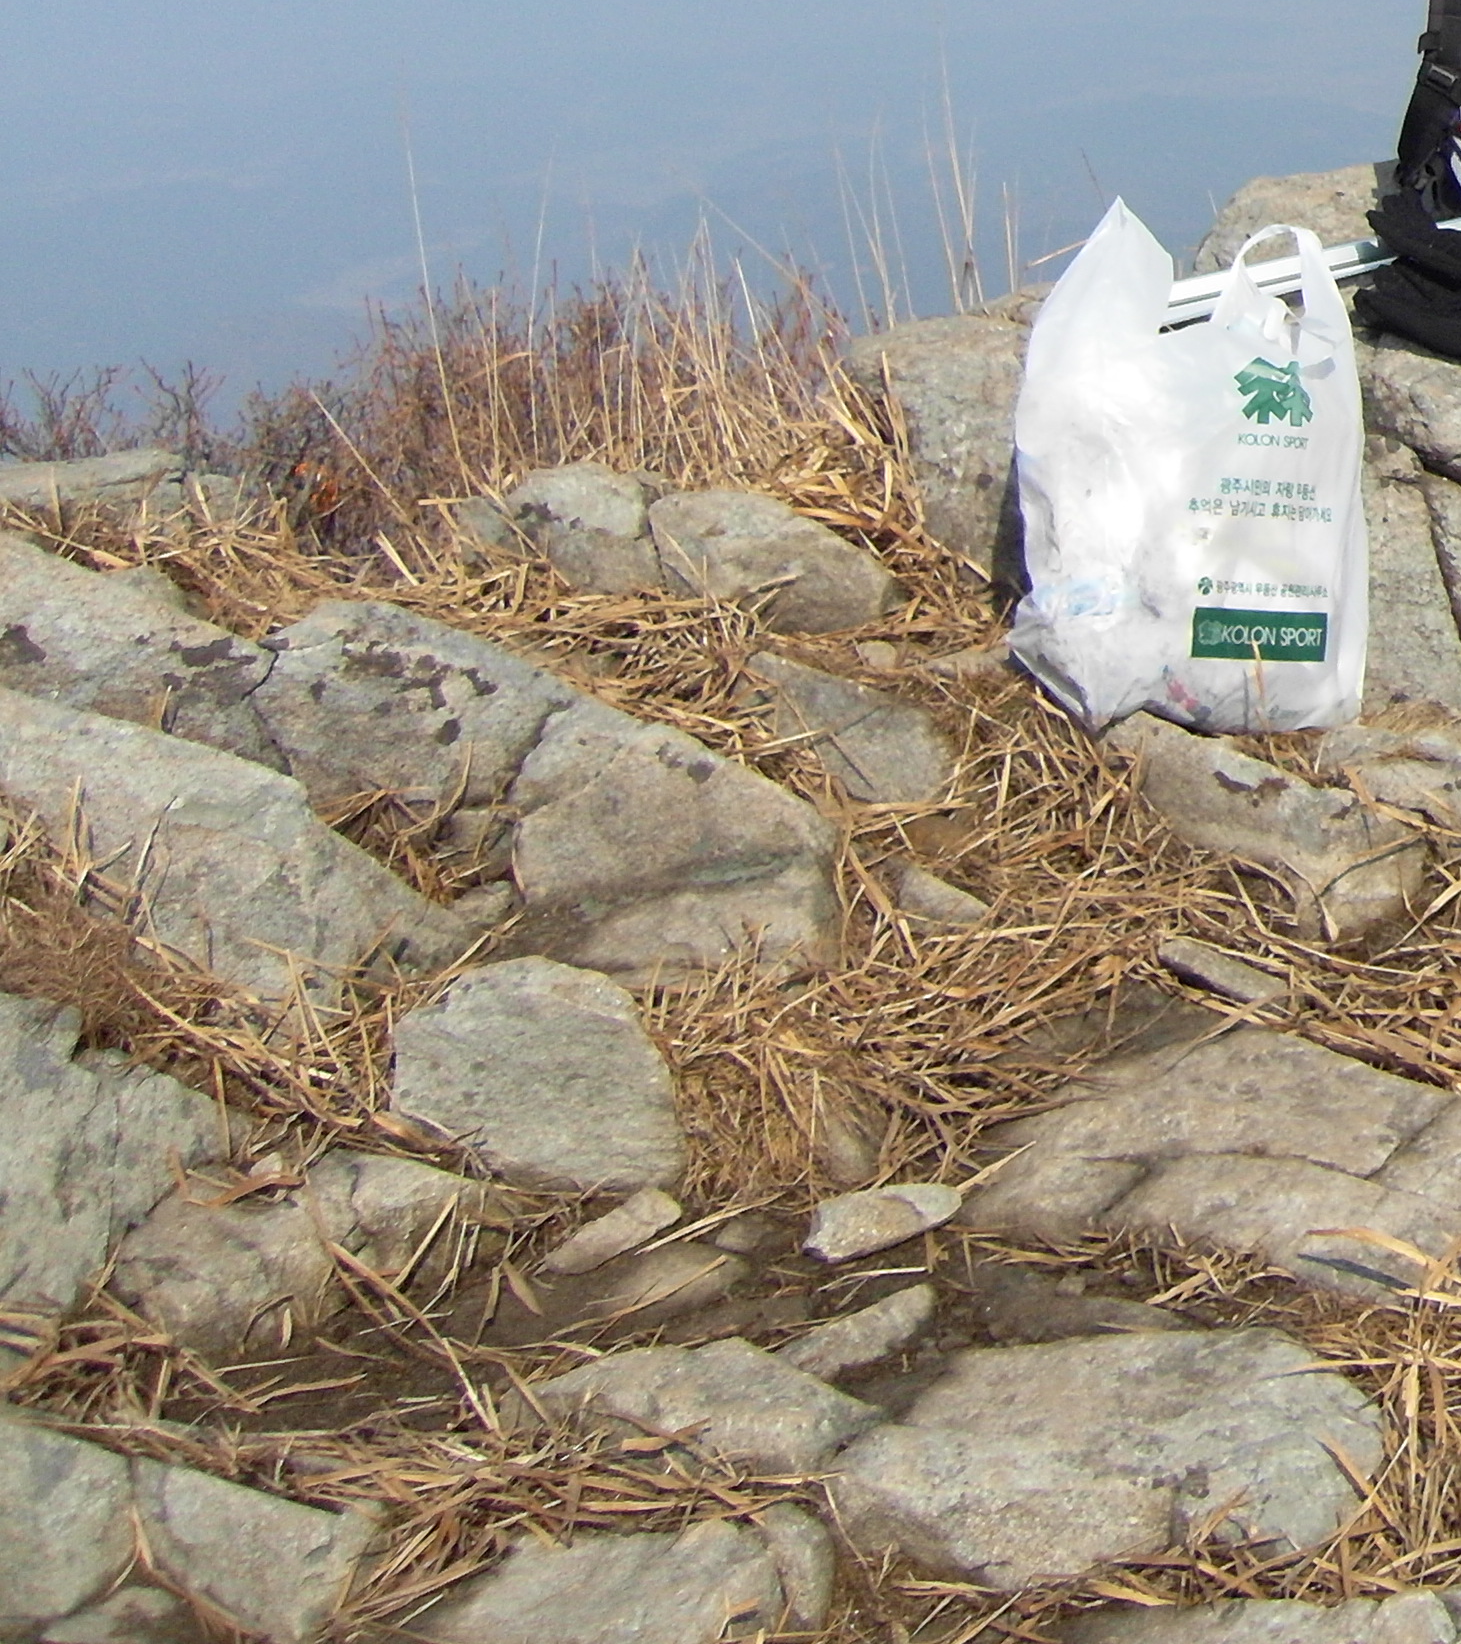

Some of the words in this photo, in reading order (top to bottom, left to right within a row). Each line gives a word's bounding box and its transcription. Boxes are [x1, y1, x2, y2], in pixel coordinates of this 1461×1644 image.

[1237, 433, 1280, 446] KOLON
[1283, 435, 1309, 449] SPORT
[1220, 477, 1271, 496] 광주시민의
[1275, 481, 1295, 499] 자랑
[1188, 497, 1223, 516] 추억은
[1230, 499, 1266, 517] 남기시고
[1271, 502, 1297, 521] 휴지는
[1221, 624, 1276, 646] KOLON
[1280, 627, 1322, 647] SPORT
